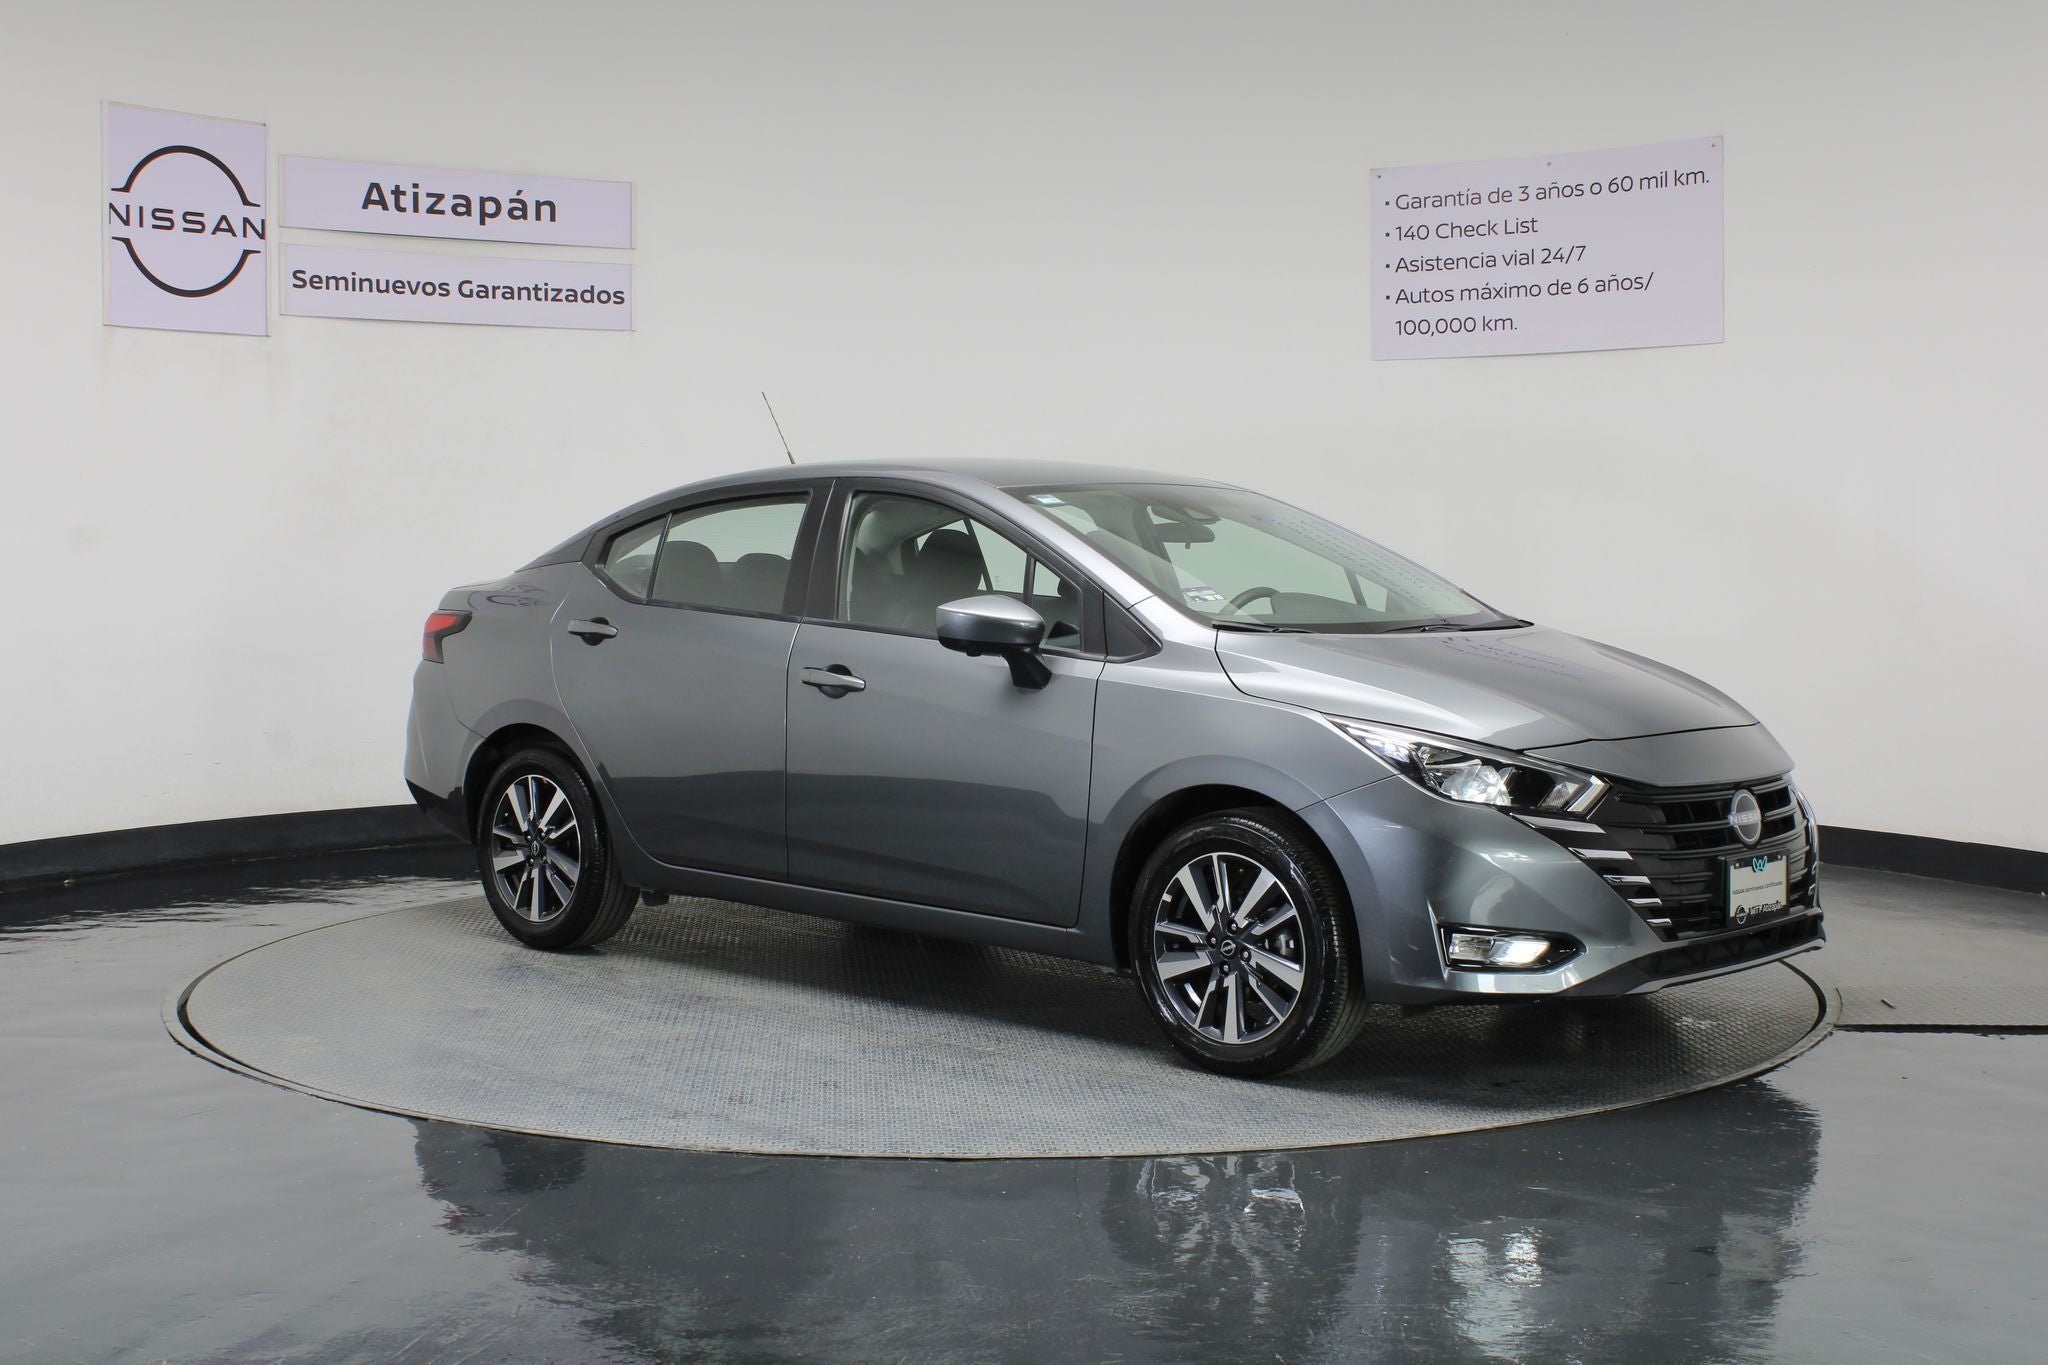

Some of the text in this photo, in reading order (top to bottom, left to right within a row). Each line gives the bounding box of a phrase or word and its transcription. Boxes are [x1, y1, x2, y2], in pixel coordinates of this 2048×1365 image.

[361, 181, 558, 227] Atizapán
[1395, 169, 1710, 211] Garantía de 3 años o 60 mil km.
[108, 202, 267, 241] NISSAN
[1395, 217, 1539, 241] 140 Check List
[1394, 244, 1587, 274] Asistencia vial 24/7
[292, 269, 626, 306] Seminuevos Garantizados
[1394, 271, 1655, 305] Autos máximo de 6 años/
[1394, 315, 1518, 338] 100,000 km.
